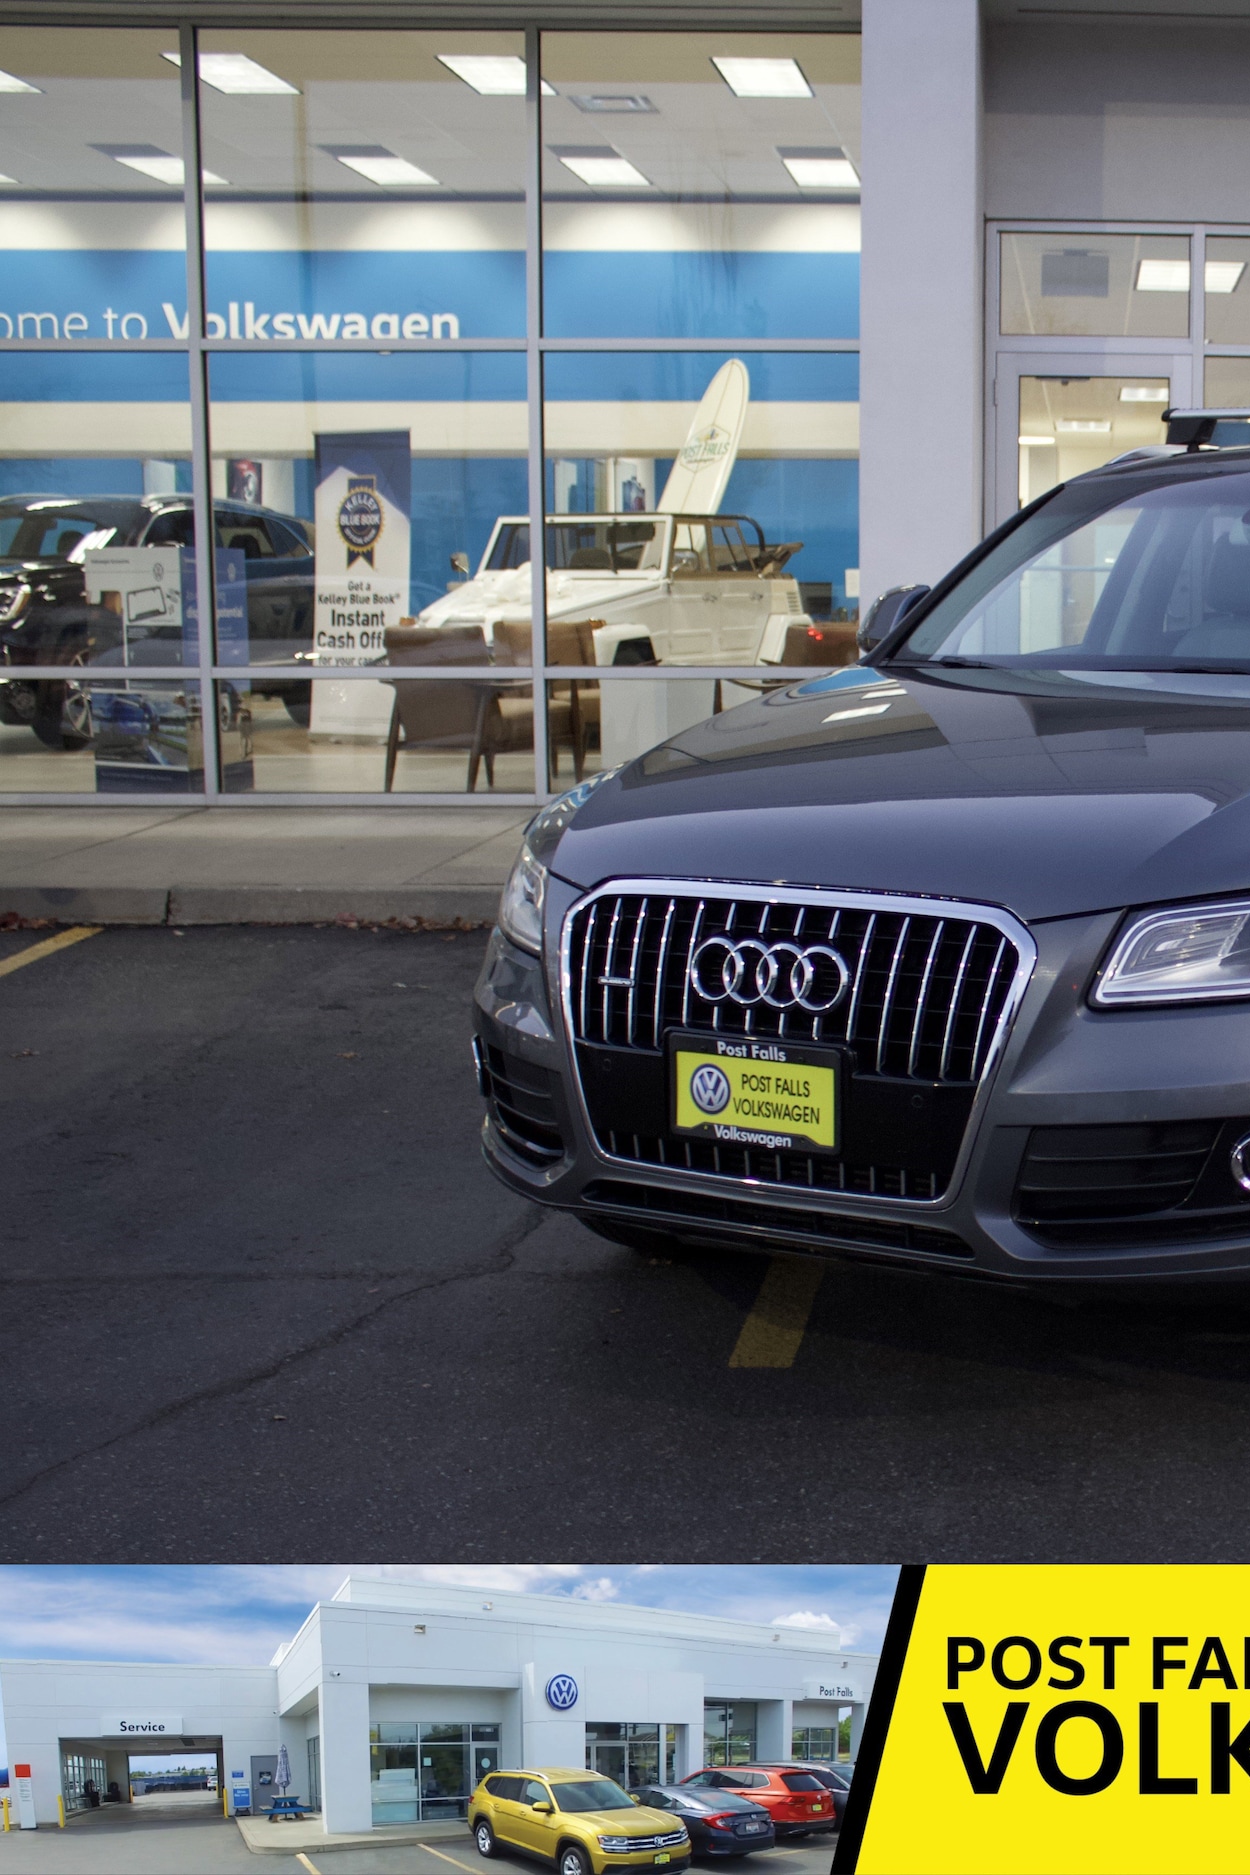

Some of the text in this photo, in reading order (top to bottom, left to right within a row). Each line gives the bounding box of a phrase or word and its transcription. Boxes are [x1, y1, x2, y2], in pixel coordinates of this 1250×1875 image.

[102, 307, 148, 339] to
[162, 302, 460, 339] Volkswagen
[347, 581, 371, 591] Get a
[318, 593, 347, 606] Kelley
[350, 594, 370, 604] Blue
[331, 609, 385, 627] Instant
[317, 631, 355, 649] Cash
[717, 1041, 786, 1062] Post Falls
[742, 1074, 810, 1098] POST FALLS
[733, 1098, 820, 1125] VOLKSWAGEN
[714, 1125, 792, 1148] Volkswagen
